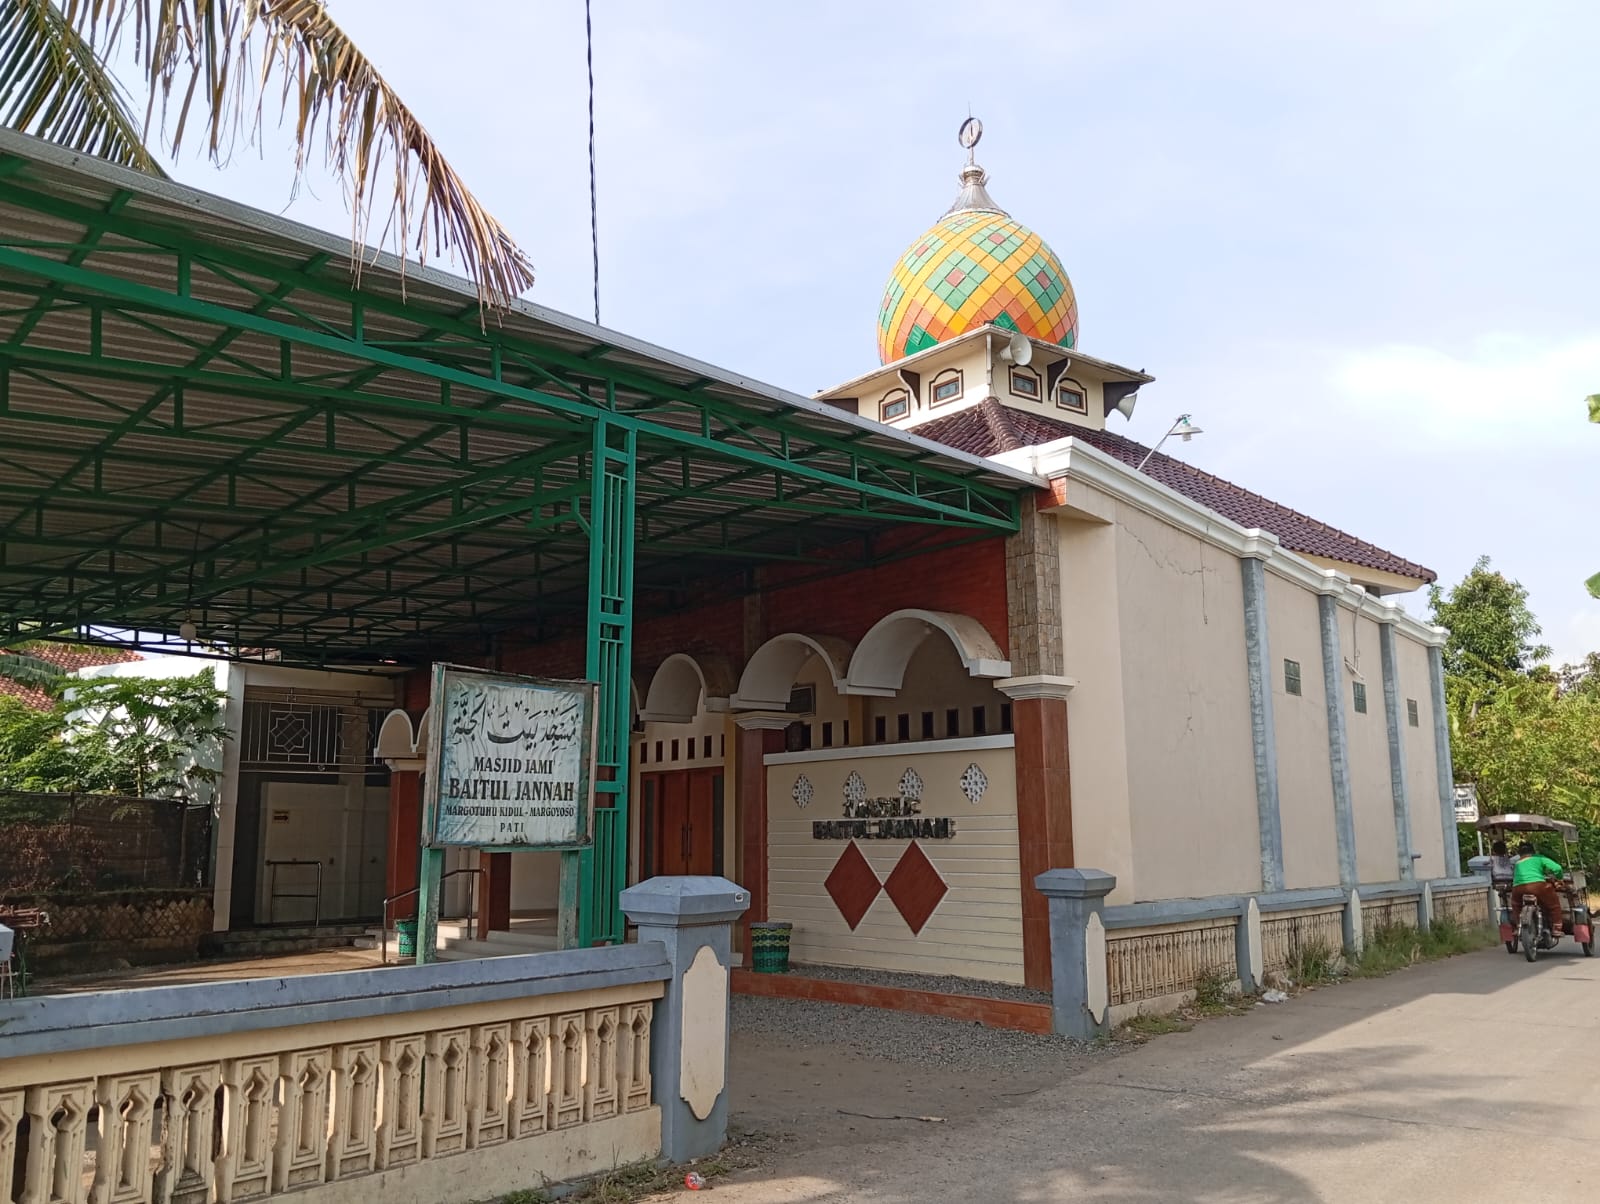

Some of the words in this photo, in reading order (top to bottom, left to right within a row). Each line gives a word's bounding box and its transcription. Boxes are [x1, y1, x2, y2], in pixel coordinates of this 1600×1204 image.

[473, 757, 522, 773] MASJID
[448, 778, 511, 801] BAITUL
[515, 781, 575, 801] JANNAH
[445, 805, 497, 816] MARGOTUHU
[499, 807, 524, 816] KIDUL
[529, 807, 574, 817] MARGOYOSO
[500, 822, 524, 832] PATI
